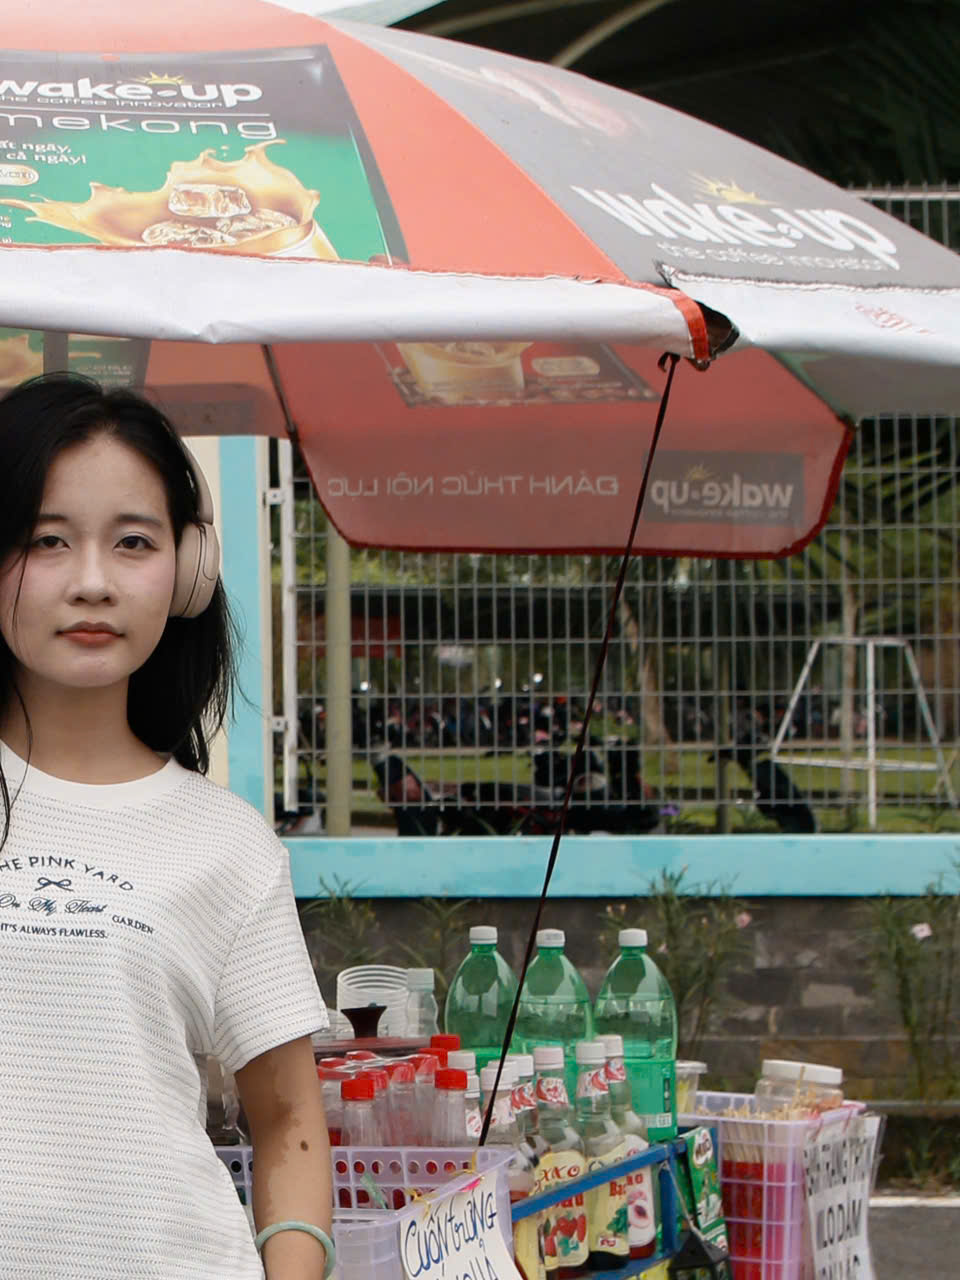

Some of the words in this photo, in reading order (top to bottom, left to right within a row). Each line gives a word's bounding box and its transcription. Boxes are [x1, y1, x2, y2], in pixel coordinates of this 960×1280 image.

[28, 855, 76, 869] PINK
[83, 863, 134, 891] YARD
[0, 922, 18, 933] IT'S
[19, 924, 58, 937] ALWAYS
[112, 914, 155, 935] GARDEN
